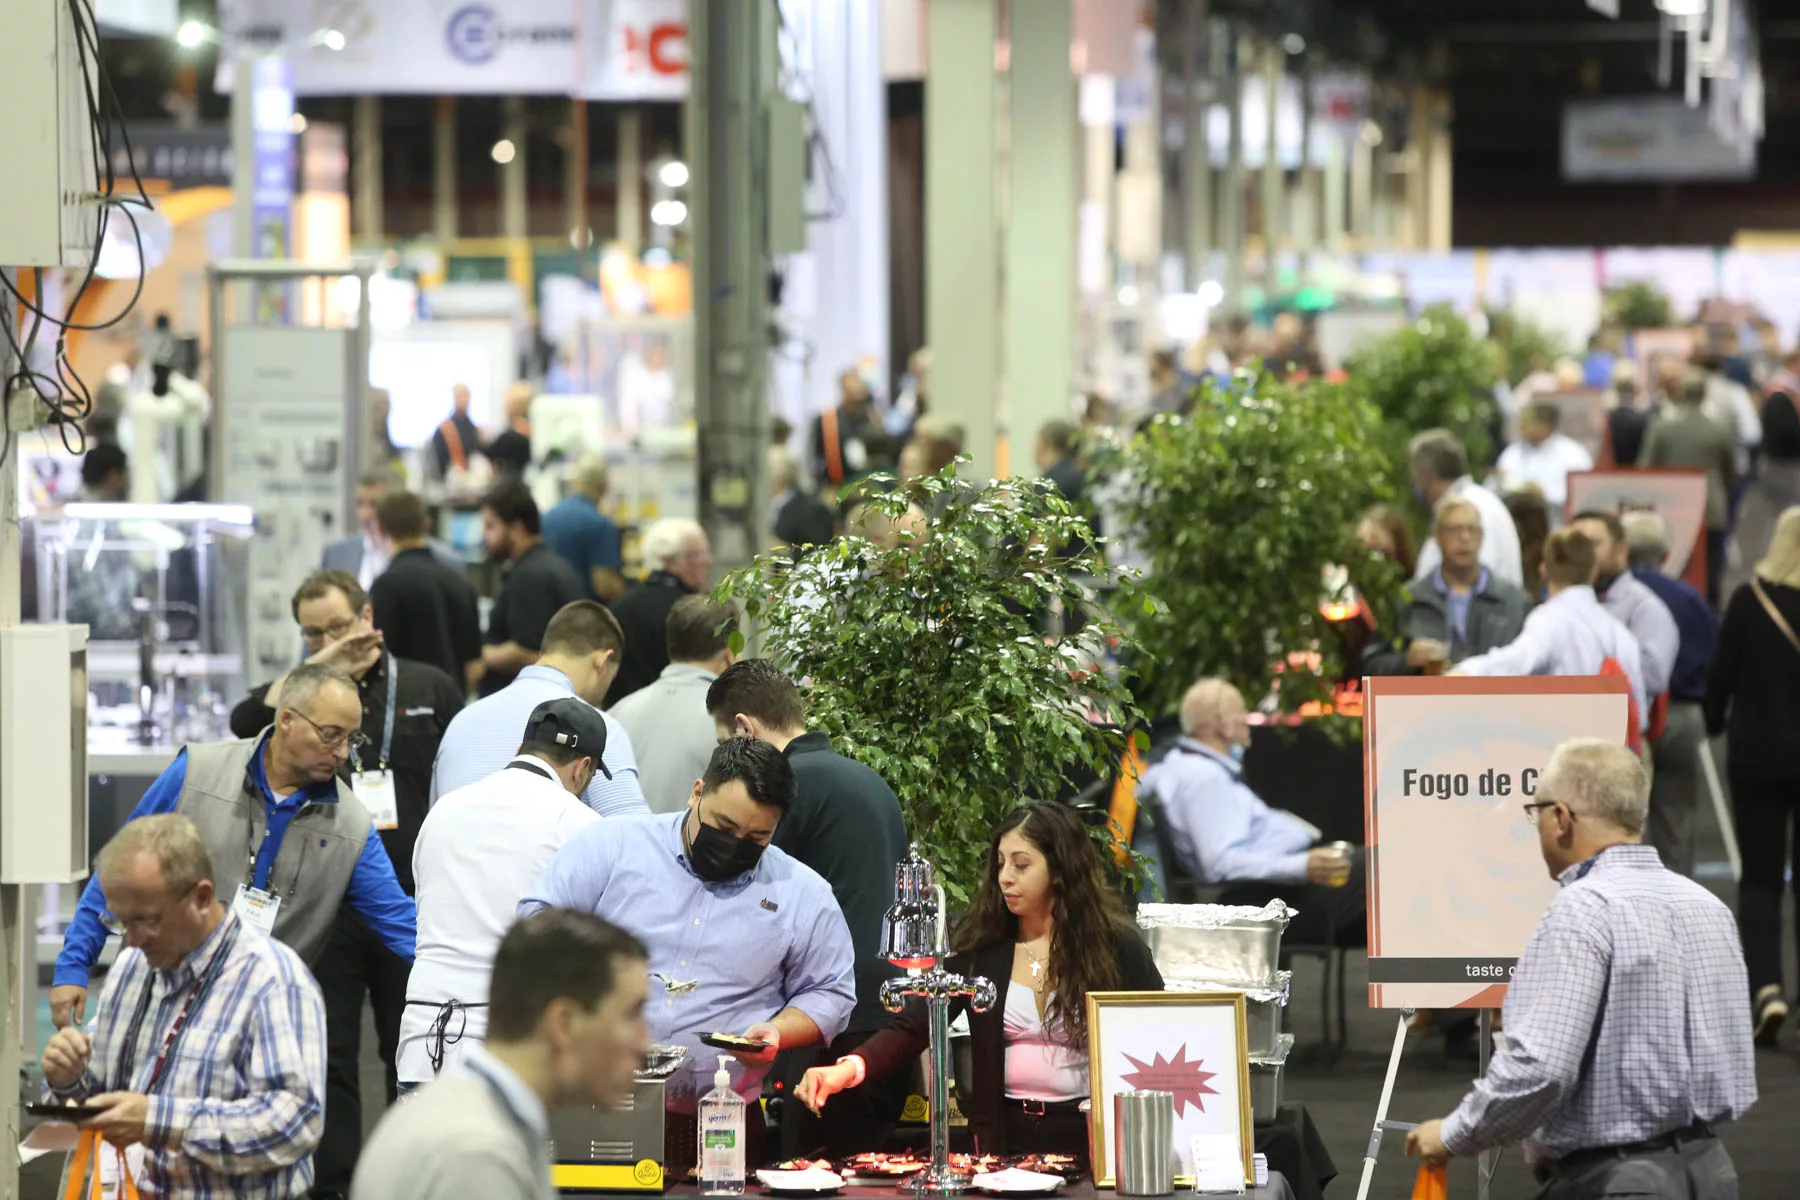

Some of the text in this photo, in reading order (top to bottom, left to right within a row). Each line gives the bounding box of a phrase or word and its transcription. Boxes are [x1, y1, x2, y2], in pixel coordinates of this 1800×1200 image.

[1403, 768, 1543, 800] Fogo de C
[1465, 964, 1504, 977] taste
